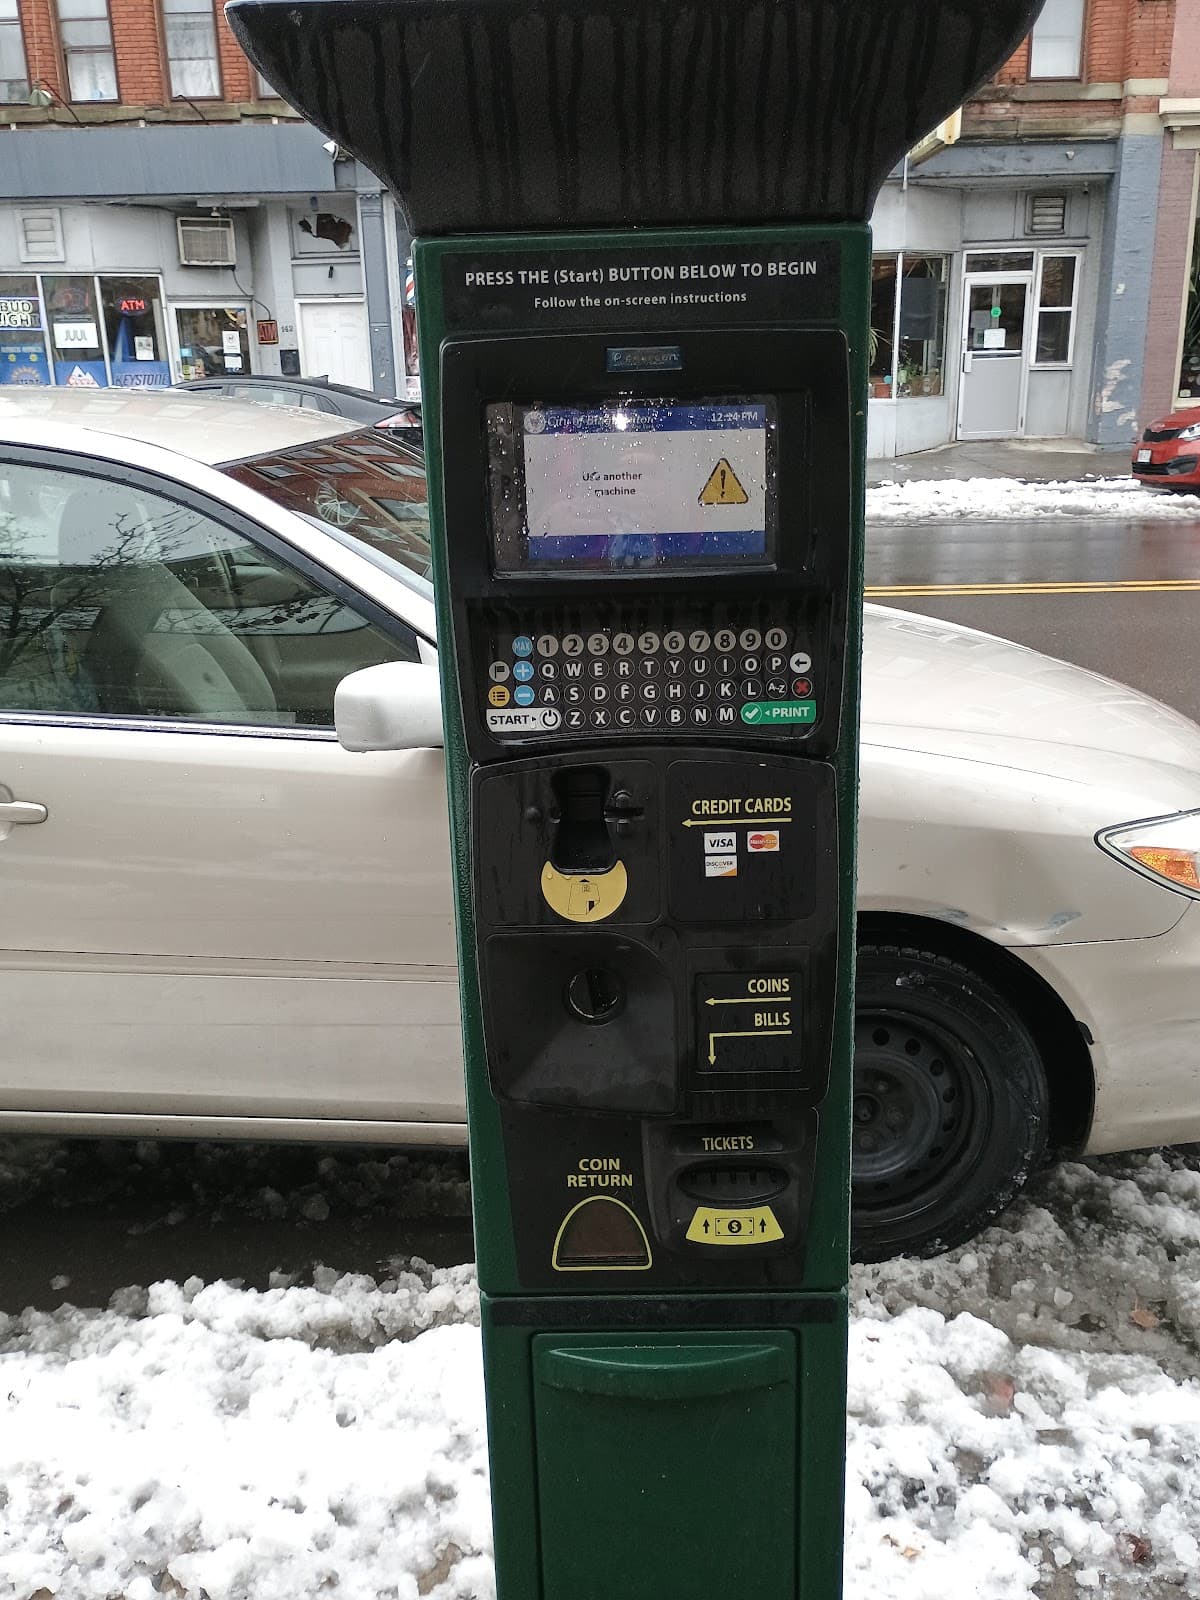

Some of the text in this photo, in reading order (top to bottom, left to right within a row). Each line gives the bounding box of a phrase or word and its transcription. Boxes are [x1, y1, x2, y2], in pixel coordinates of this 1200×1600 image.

[465, 261, 817, 286] PRESS THE (Start) BUTTON BELOW TO BEGIN
[0, 300, 33, 314] BUD
[121, 299, 145, 311] ATM
[534, 291, 747, 309] Follow the on-screen instructions
[0, 313, 40, 327] IGHT
[603, 471, 643, 481] another
[594, 486, 636, 496] machine
[542, 639, 551, 653] 1
[568, 639, 578, 652] 2
[593, 638, 603, 652] 3
[617, 637, 628, 651] 4
[644, 637, 653, 650] 5
[668, 636, 679, 649] 6
[694, 635, 704, 649] 7
[720, 634, 731, 648] 8
[745, 633, 756, 647] 9
[542, 667, 554, 678] Q
[566, 664, 581, 676] W
[594, 663, 603, 675] E
[619, 662, 629, 675] R
[644, 661, 654, 674] T
[669, 660, 680, 673] Y
[694, 659, 705, 673] U
[771, 657, 782, 671] P
[543, 688, 555, 701] A
[569, 687, 579, 700] S
[594, 687, 606, 700] D
[620, 685, 630, 699] F
[643, 685, 656, 699] G
[669, 684, 681, 698] H
[697, 684, 704, 697] J
[721, 683, 731, 696] K
[747, 682, 756, 696] L
[569, 707, 733, 725] Z X C V B N M
[772, 706, 810, 718] PRINT
[490, 714, 530, 725] START
[691, 797, 792, 815] CREDIT CARDS
[709, 838, 734, 848] VISA
[747, 978, 790, 993] COINS
[754, 1012, 791, 1027] BILLS
[702, 1136, 754, 1151] TICKETS
[578, 1158, 620, 1171] COIN
[567, 1174, 633, 1187] RETURN
